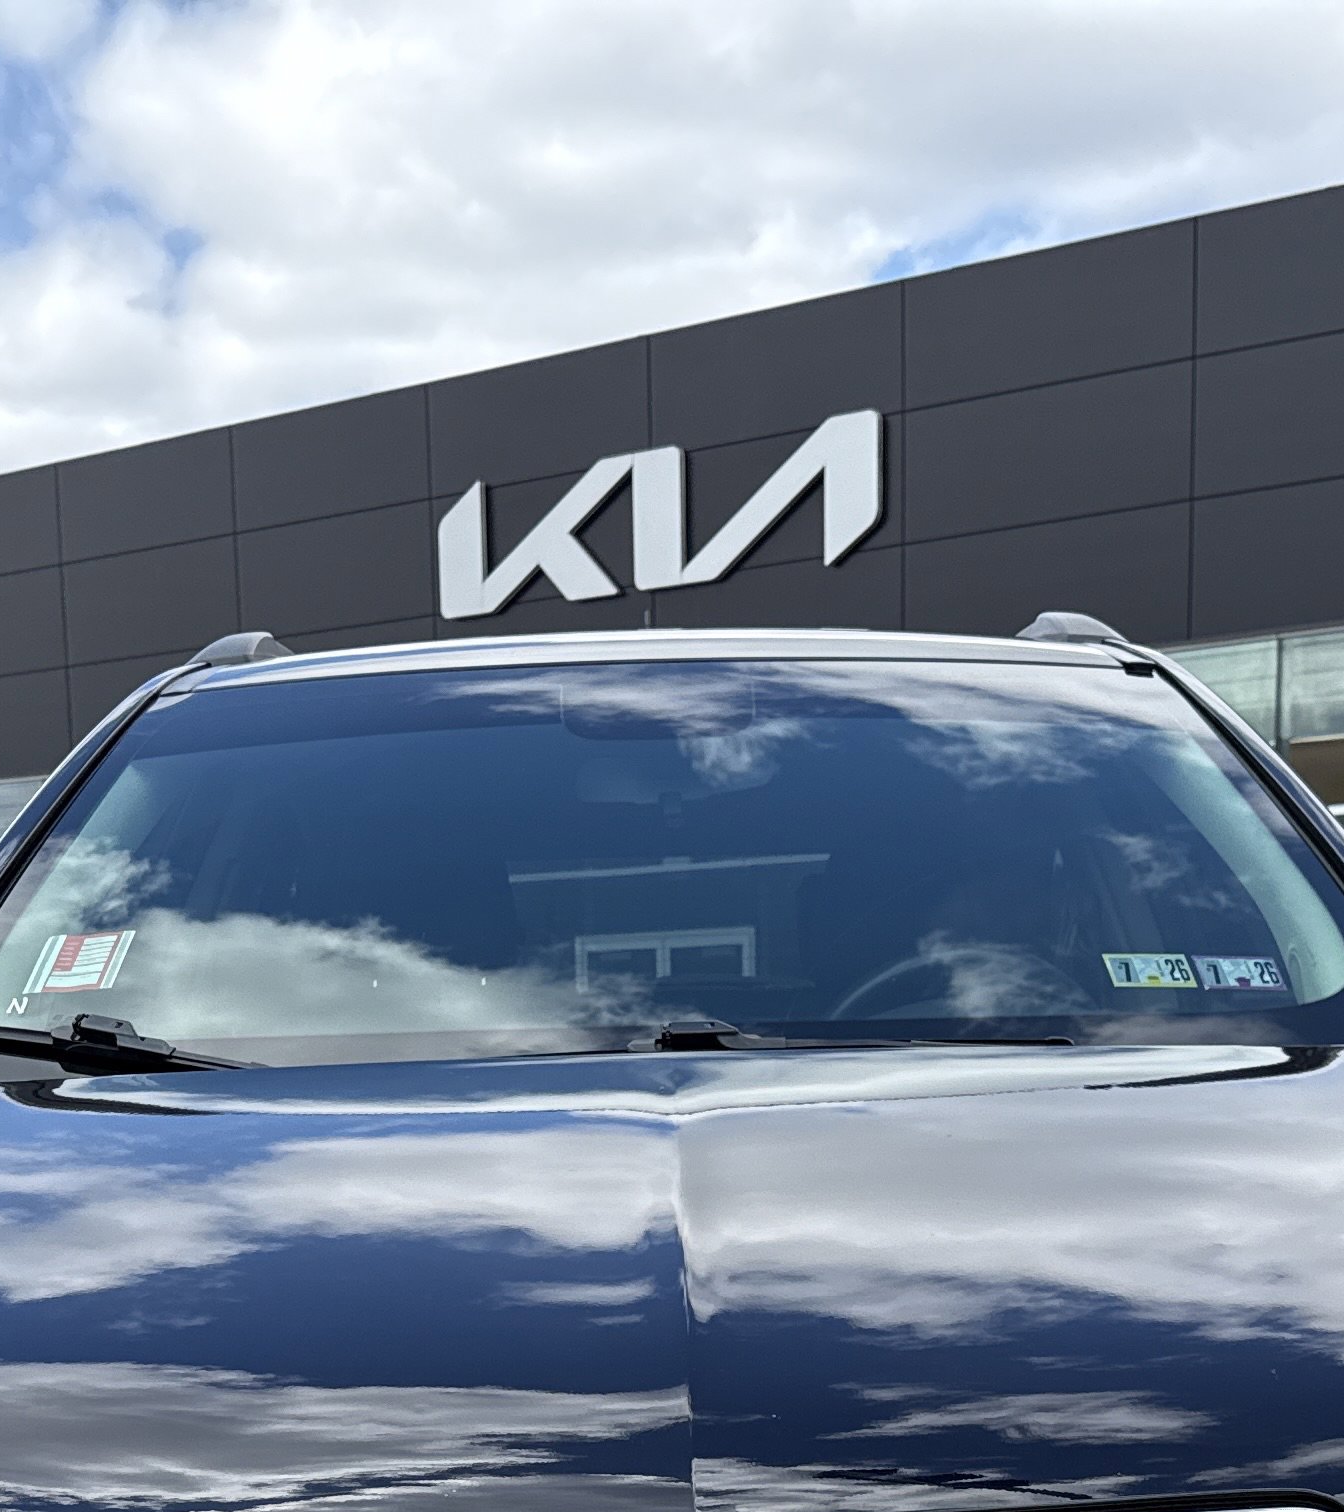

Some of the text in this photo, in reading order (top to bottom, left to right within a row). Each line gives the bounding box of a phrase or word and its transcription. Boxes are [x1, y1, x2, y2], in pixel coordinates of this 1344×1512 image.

[438, 409, 882, 620] KIA
[1164, 958, 1192, 982] 26
[1253, 961, 1281, 985] 26
